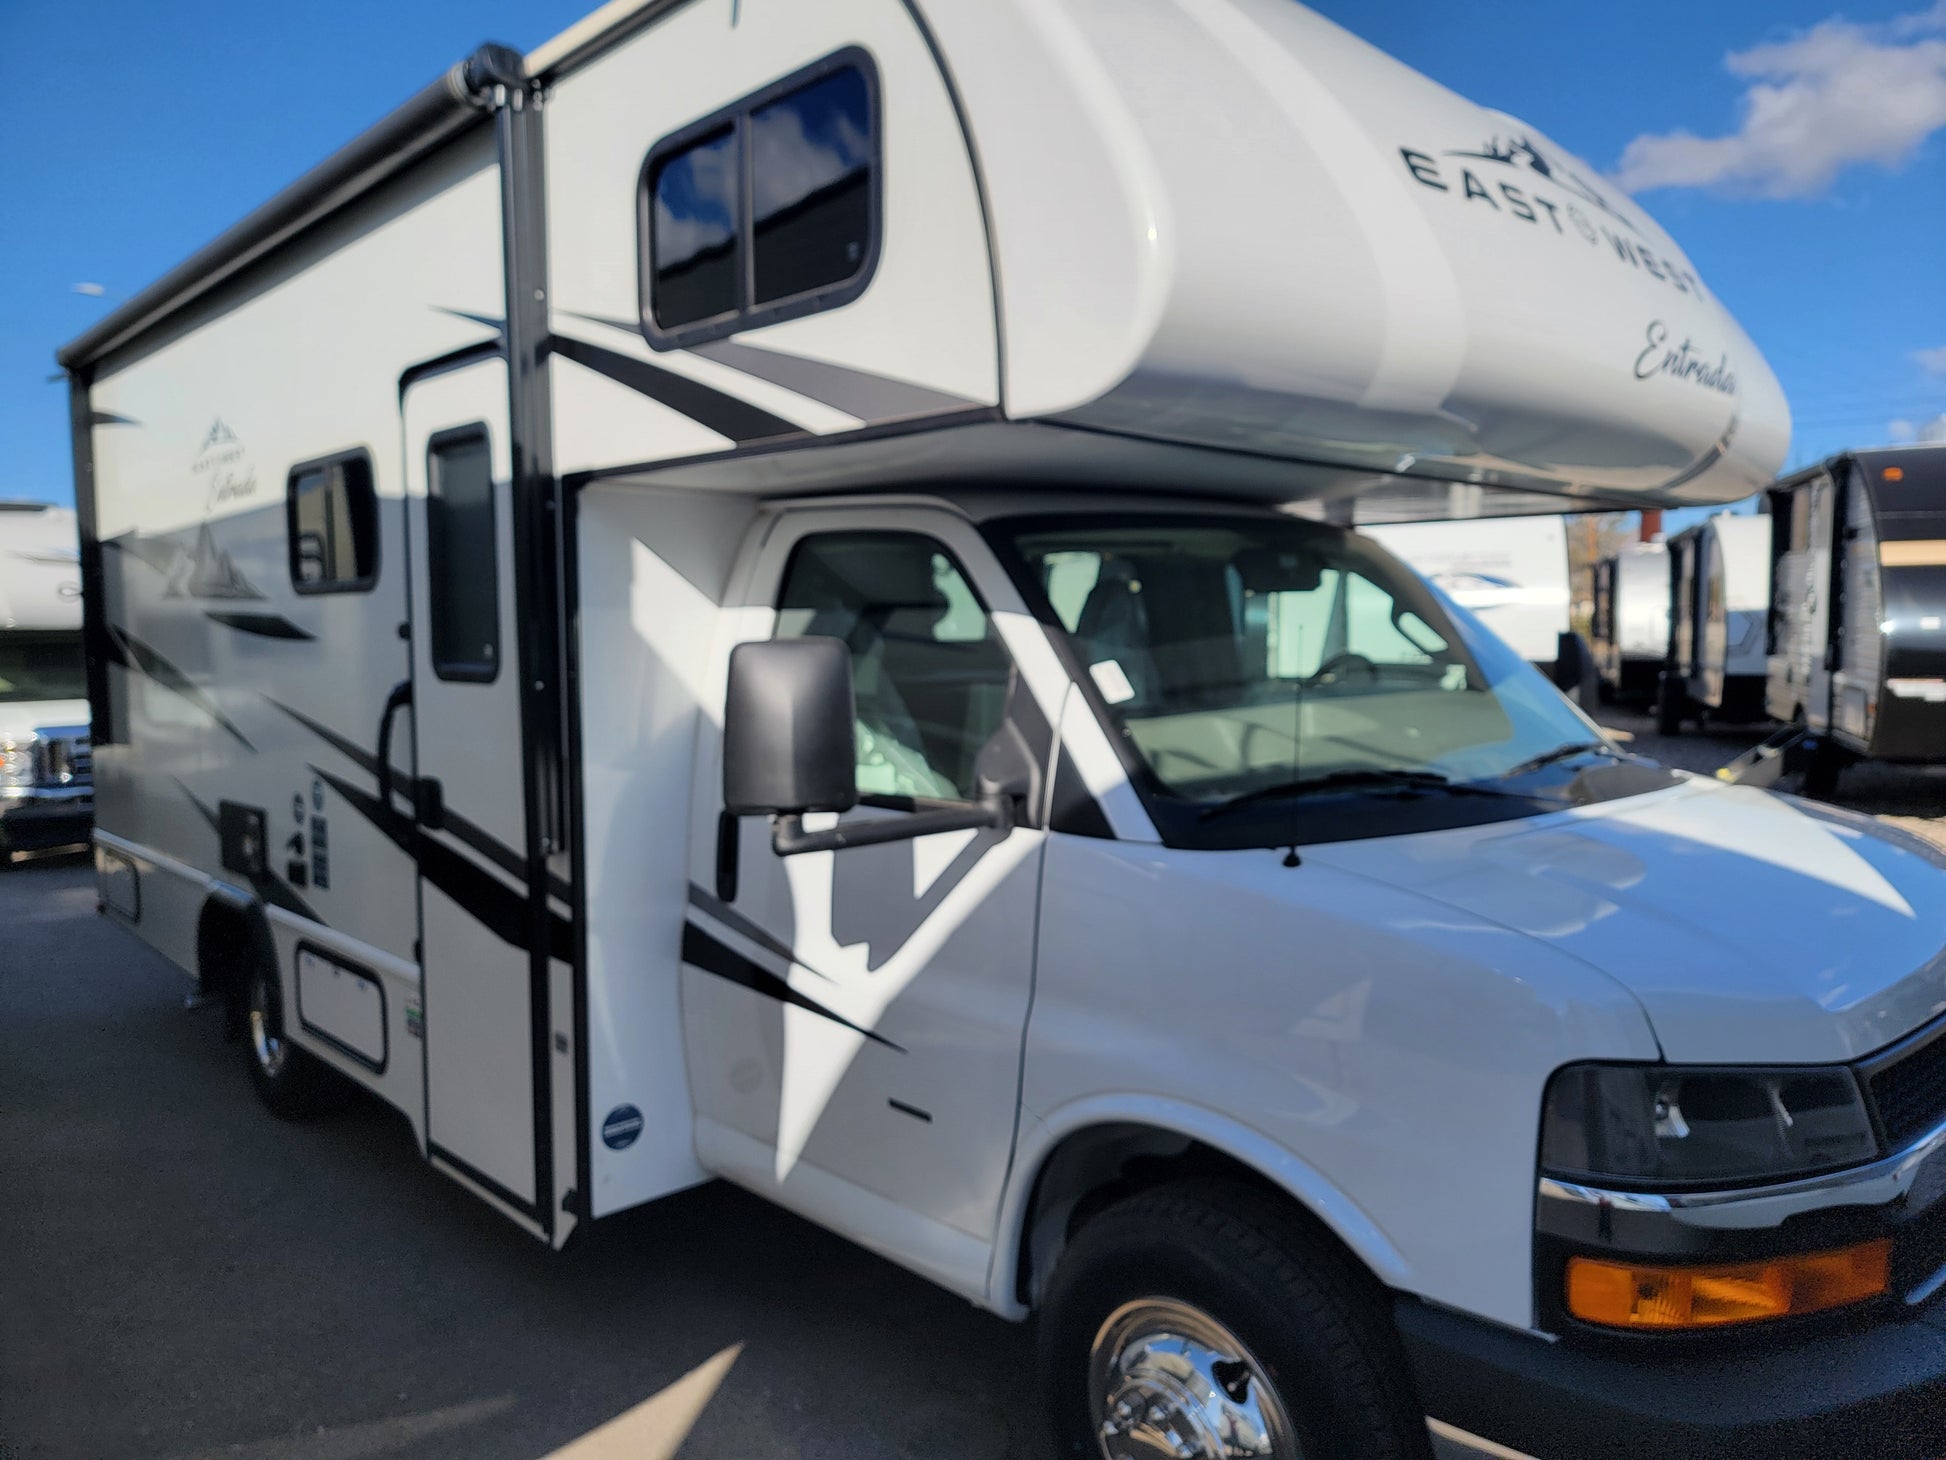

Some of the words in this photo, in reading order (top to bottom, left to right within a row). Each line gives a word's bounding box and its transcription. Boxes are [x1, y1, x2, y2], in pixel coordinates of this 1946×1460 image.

[1399, 146, 1563, 234] EAST
[1601, 226, 1705, 301] WEST
[1633, 320, 1737, 395] Entrada
